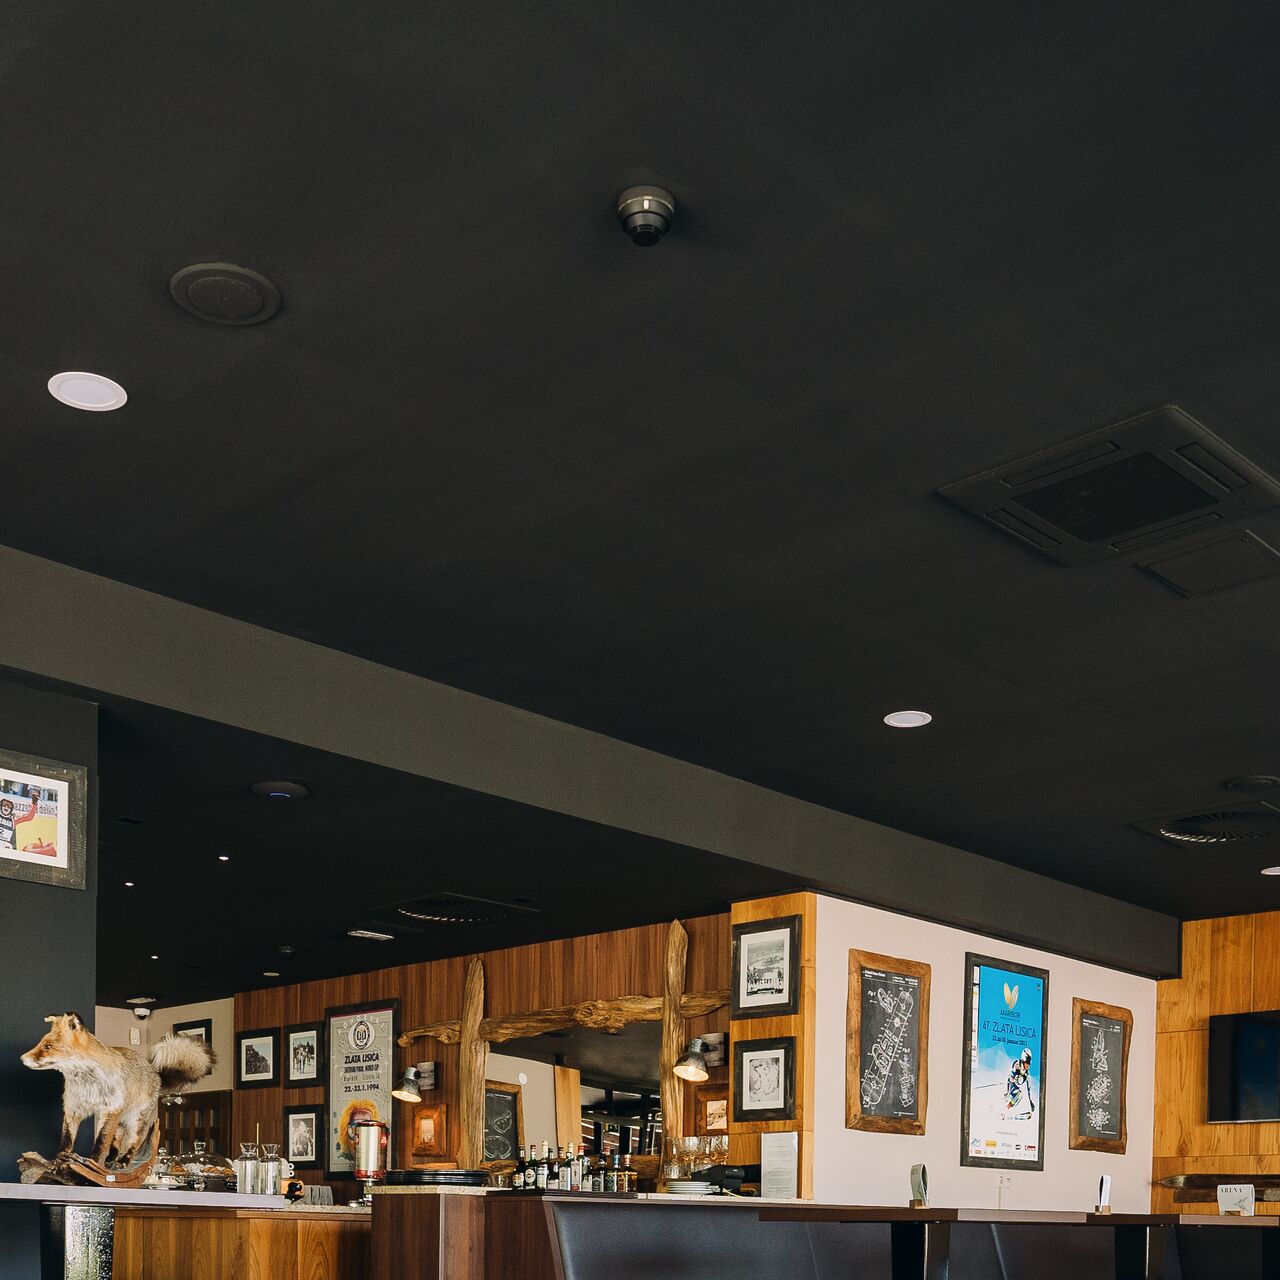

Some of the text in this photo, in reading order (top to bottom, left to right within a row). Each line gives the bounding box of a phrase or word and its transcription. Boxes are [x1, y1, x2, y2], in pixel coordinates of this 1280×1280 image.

[992, 1021, 1014, 1036] ZLATA
[1016, 1026, 1037, 1039] LISICA
[344, 1054, 361, 1064] ZLATA
